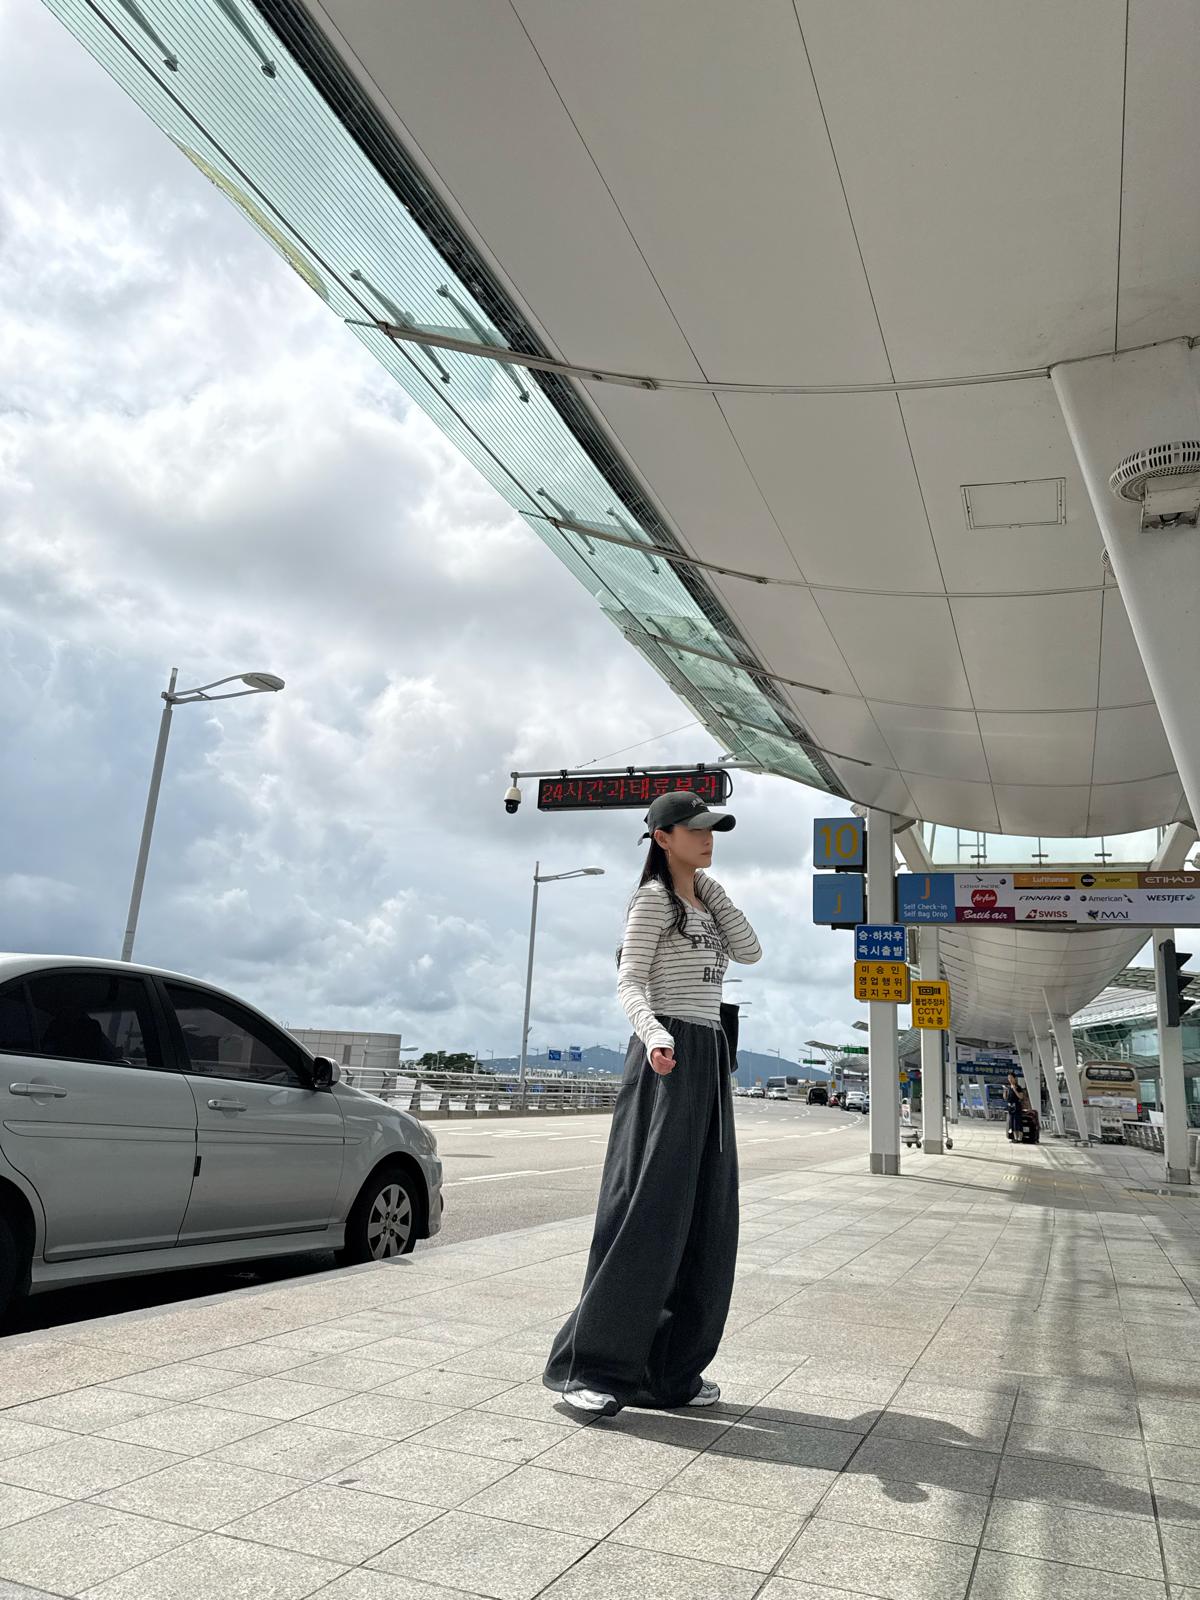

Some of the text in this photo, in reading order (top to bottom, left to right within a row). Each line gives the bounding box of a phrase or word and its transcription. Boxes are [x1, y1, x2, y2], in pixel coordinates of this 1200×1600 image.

[820, 823, 858, 859] 10
[1145, 876, 1195, 884] ETIHAD
[920, 878, 931, 900] J
[1146, 894, 1186, 903] WESTJET
[962, 909, 1008, 919] Batik air
[1038, 910, 1068, 918] SWISS
[1101, 911, 1129, 919] MAI
[858, 945, 903, 957] 즉시출발
[917, 1007, 942, 1016] CCTV
